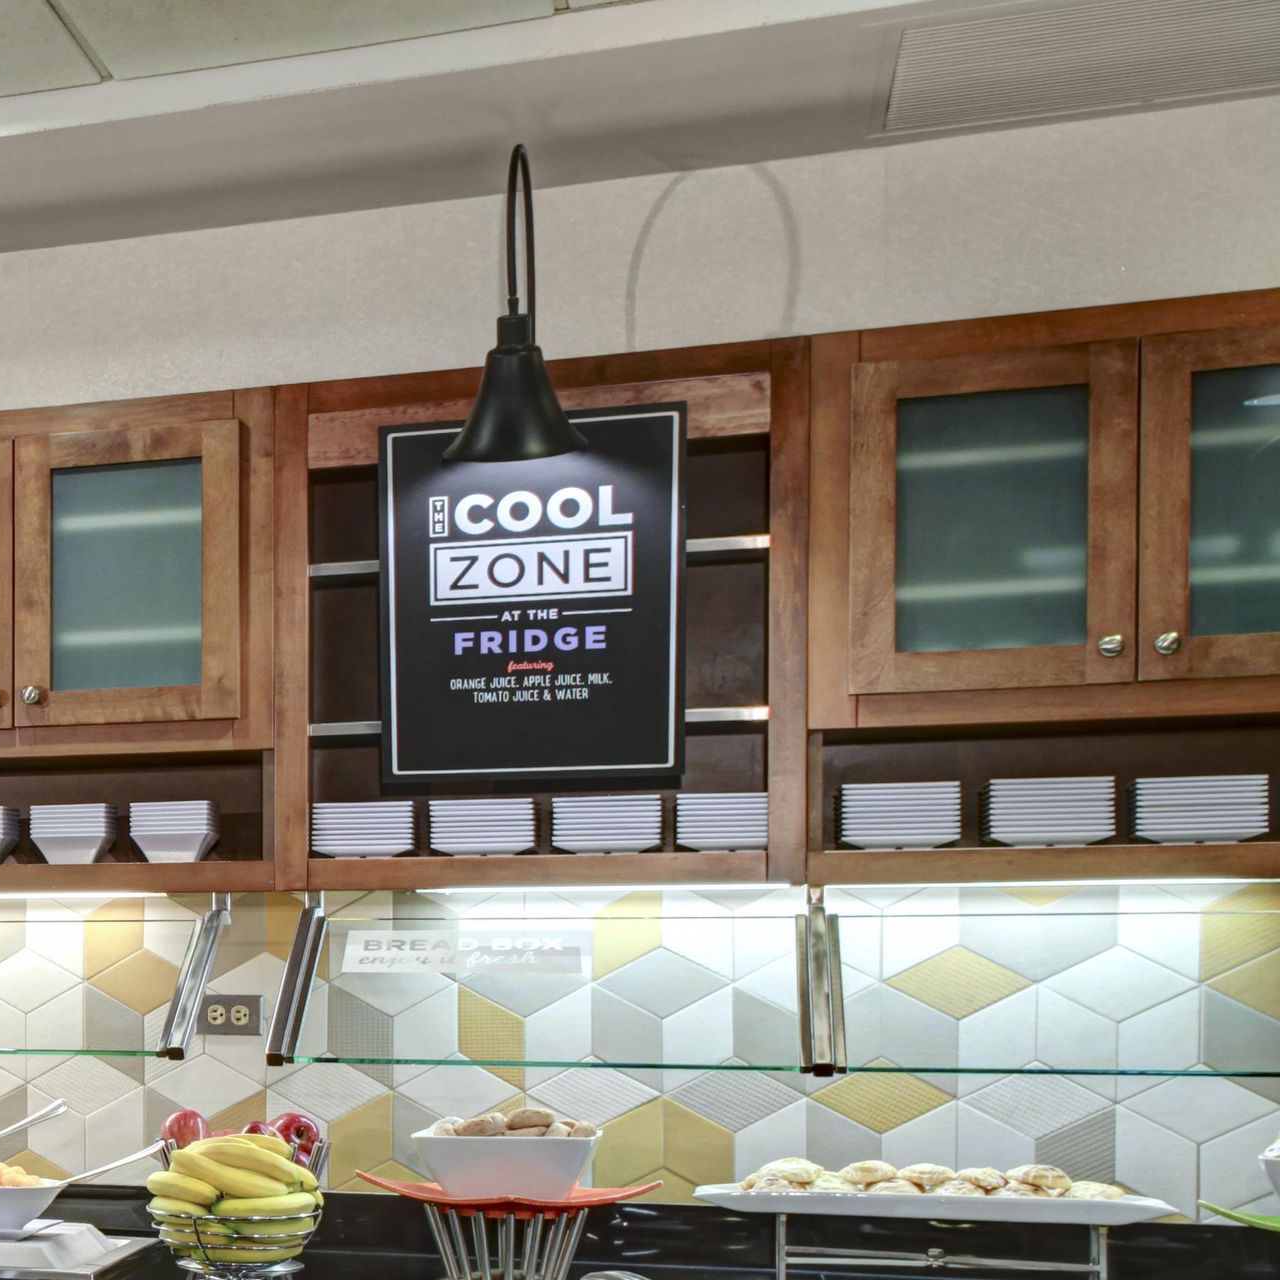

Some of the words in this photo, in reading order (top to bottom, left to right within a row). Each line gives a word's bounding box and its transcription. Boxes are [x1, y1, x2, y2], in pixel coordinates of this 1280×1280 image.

[434, 501, 444, 533] THE
[454, 485, 633, 535] COOL
[449, 547, 612, 590] ZONE
[501, 610, 521, 622] AT
[527, 608, 559, 621] THE
[454, 625, 607, 656] FRIDGE
[507, 660, 554, 673] featuring
[450, 677, 487, 690] ORANGE
[523, 675, 551, 687] APPLE
[473, 691, 509, 704] TOMATO
[513, 690, 539, 702] JUICE
[543, 689, 551, 701] &
[556, 688, 589, 700] WATER
[363, 938, 480, 951] BREAD
[491, 937, 564, 950] BOX
[466, 951, 537, 968] fresh
